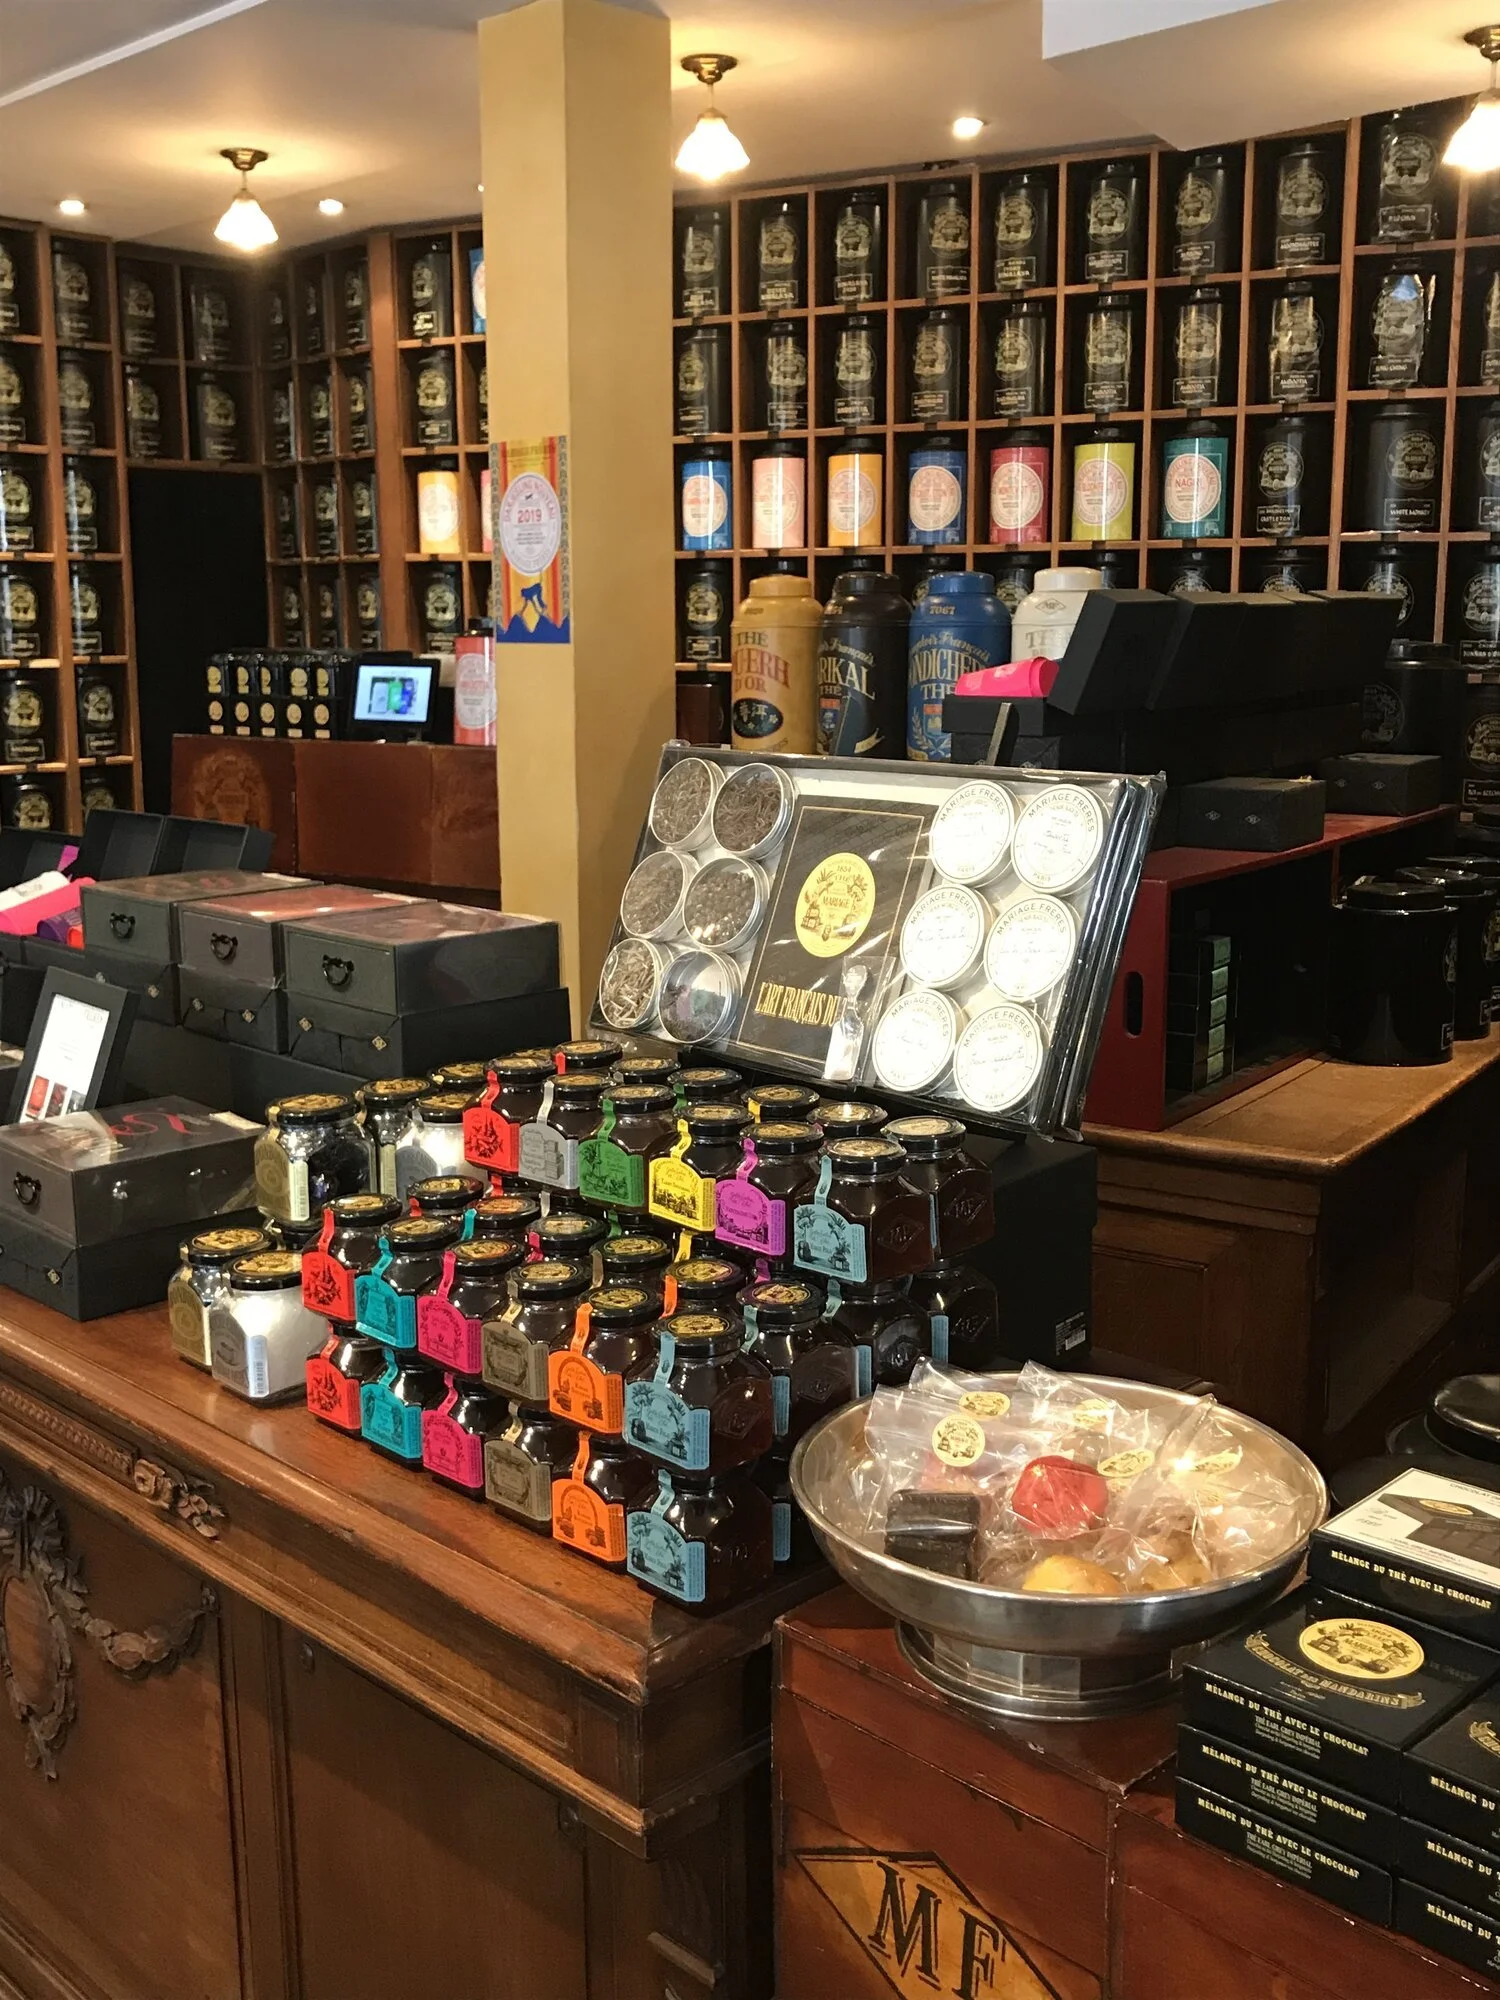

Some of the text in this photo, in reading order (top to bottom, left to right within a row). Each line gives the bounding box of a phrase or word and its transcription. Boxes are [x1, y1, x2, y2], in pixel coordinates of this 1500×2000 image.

[517, 508, 543, 524] 2019
[1373, 1564, 1386, 1574] DU
[1409, 1575, 1431, 1589] AVEC
[1433, 1584, 1444, 1594] LE
[1447, 1588, 1492, 1609] CHOCOLAT
[1253, 1646, 1300, 1676] CHOCOLAT
[1319, 1679, 1400, 1707] MANDARINS
[1248, 1700, 1260, 1712] DU
[1285, 1715, 1307, 1731] AVEC
[1310, 1725, 1320, 1736] LE
[1324, 1731, 1369, 1757] CHOCOLAT
[1246, 1762, 1257, 1774] DU
[1282, 1778, 1304, 1794] AVEC
[1307, 1788, 1318, 1800] LE
[1321, 1795, 1367, 1821] CHOCOLAT
[1482, 1798, 1496, 1811] DU
[1240, 1816, 1252, 1828] DU
[1276, 1834, 1298, 1850] AVEC
[1301, 1845, 1312, 1857] LE
[1314, 1853, 1360, 1879] CHOCOLAT
[1478, 1863, 1492, 1876] DU
[867, 1859, 1008, 2000] MF
[1477, 1927, 1492, 1939] DU
